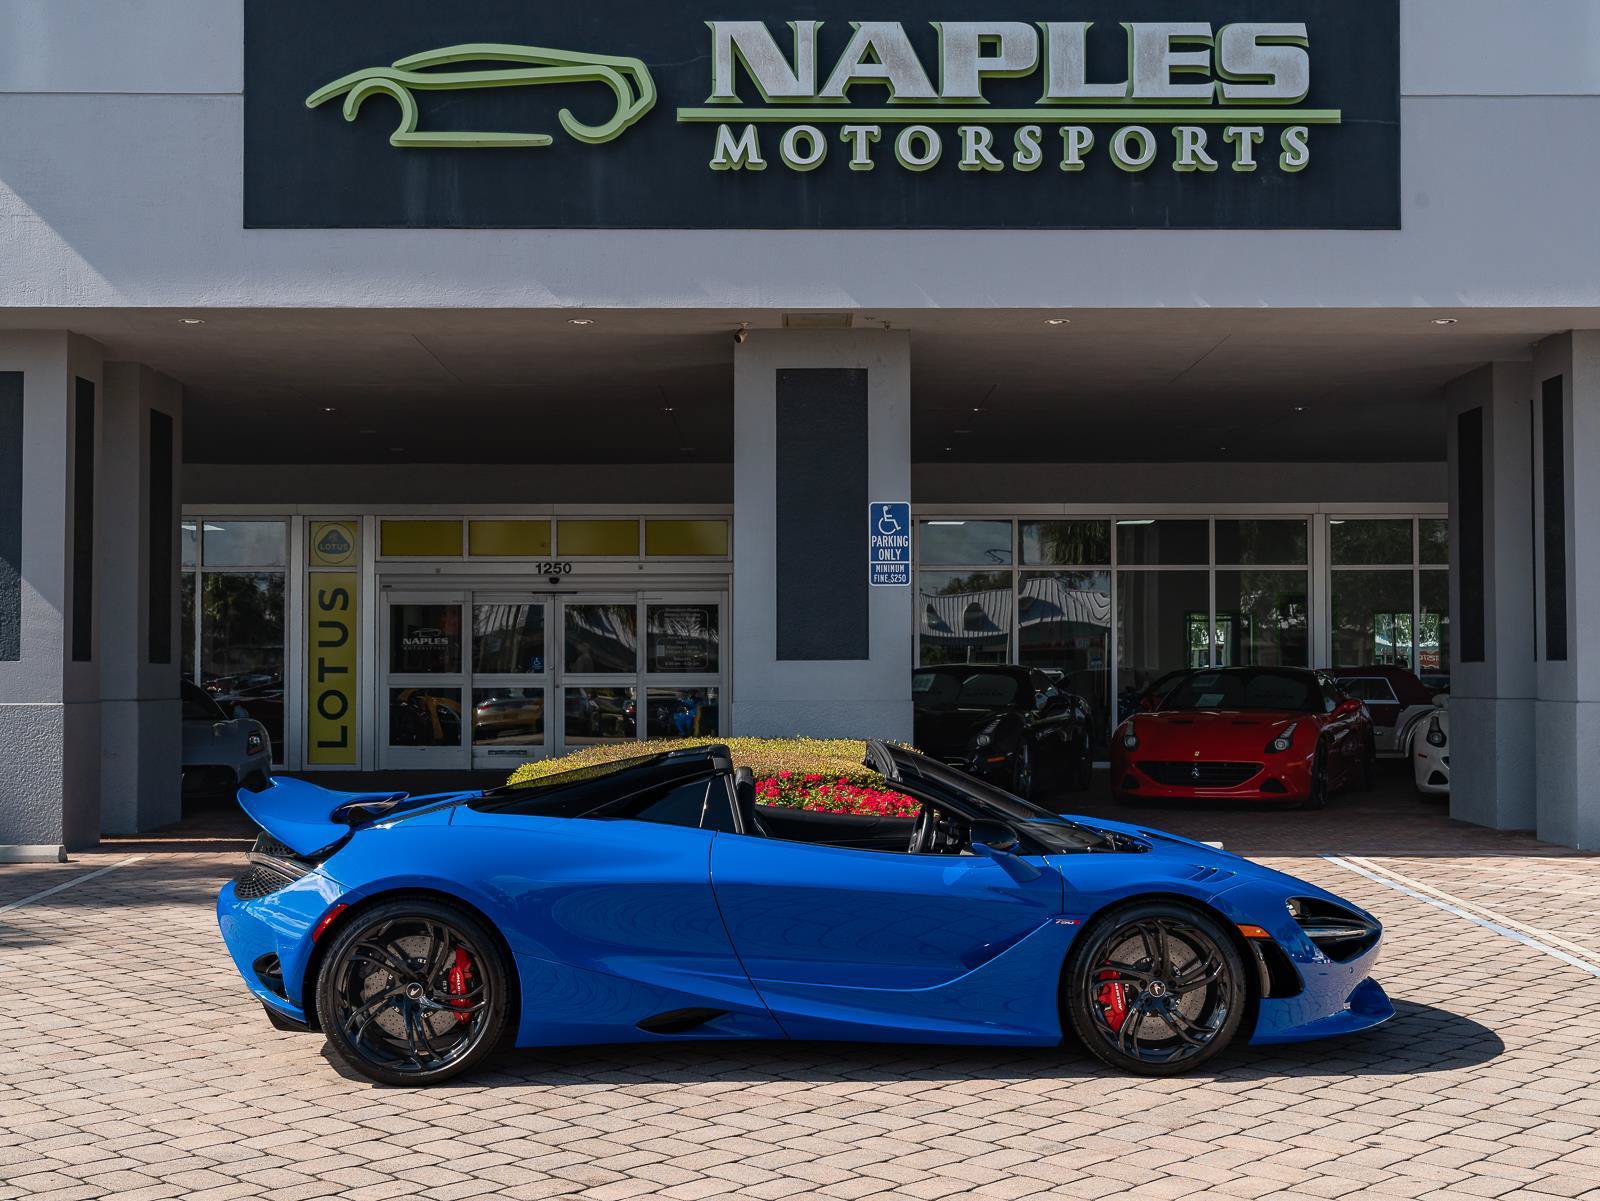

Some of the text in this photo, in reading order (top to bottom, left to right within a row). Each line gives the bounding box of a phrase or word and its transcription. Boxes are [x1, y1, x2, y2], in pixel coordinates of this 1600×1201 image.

[704, 21, 1309, 104] NAPLES
[709, 124, 1309, 171] MOTORSPORTS
[320, 543, 349, 551] LOTUS
[871, 535, 908, 547] PARKING
[878, 548, 901, 560] ONLY
[536, 562, 572, 574] 1250
[875, 564, 905, 573] MINIMUM
[873, 574, 907, 583] FINE $250
[402, 637, 449, 645] NAPLES
[317, 587, 349, 748] LOTUS
